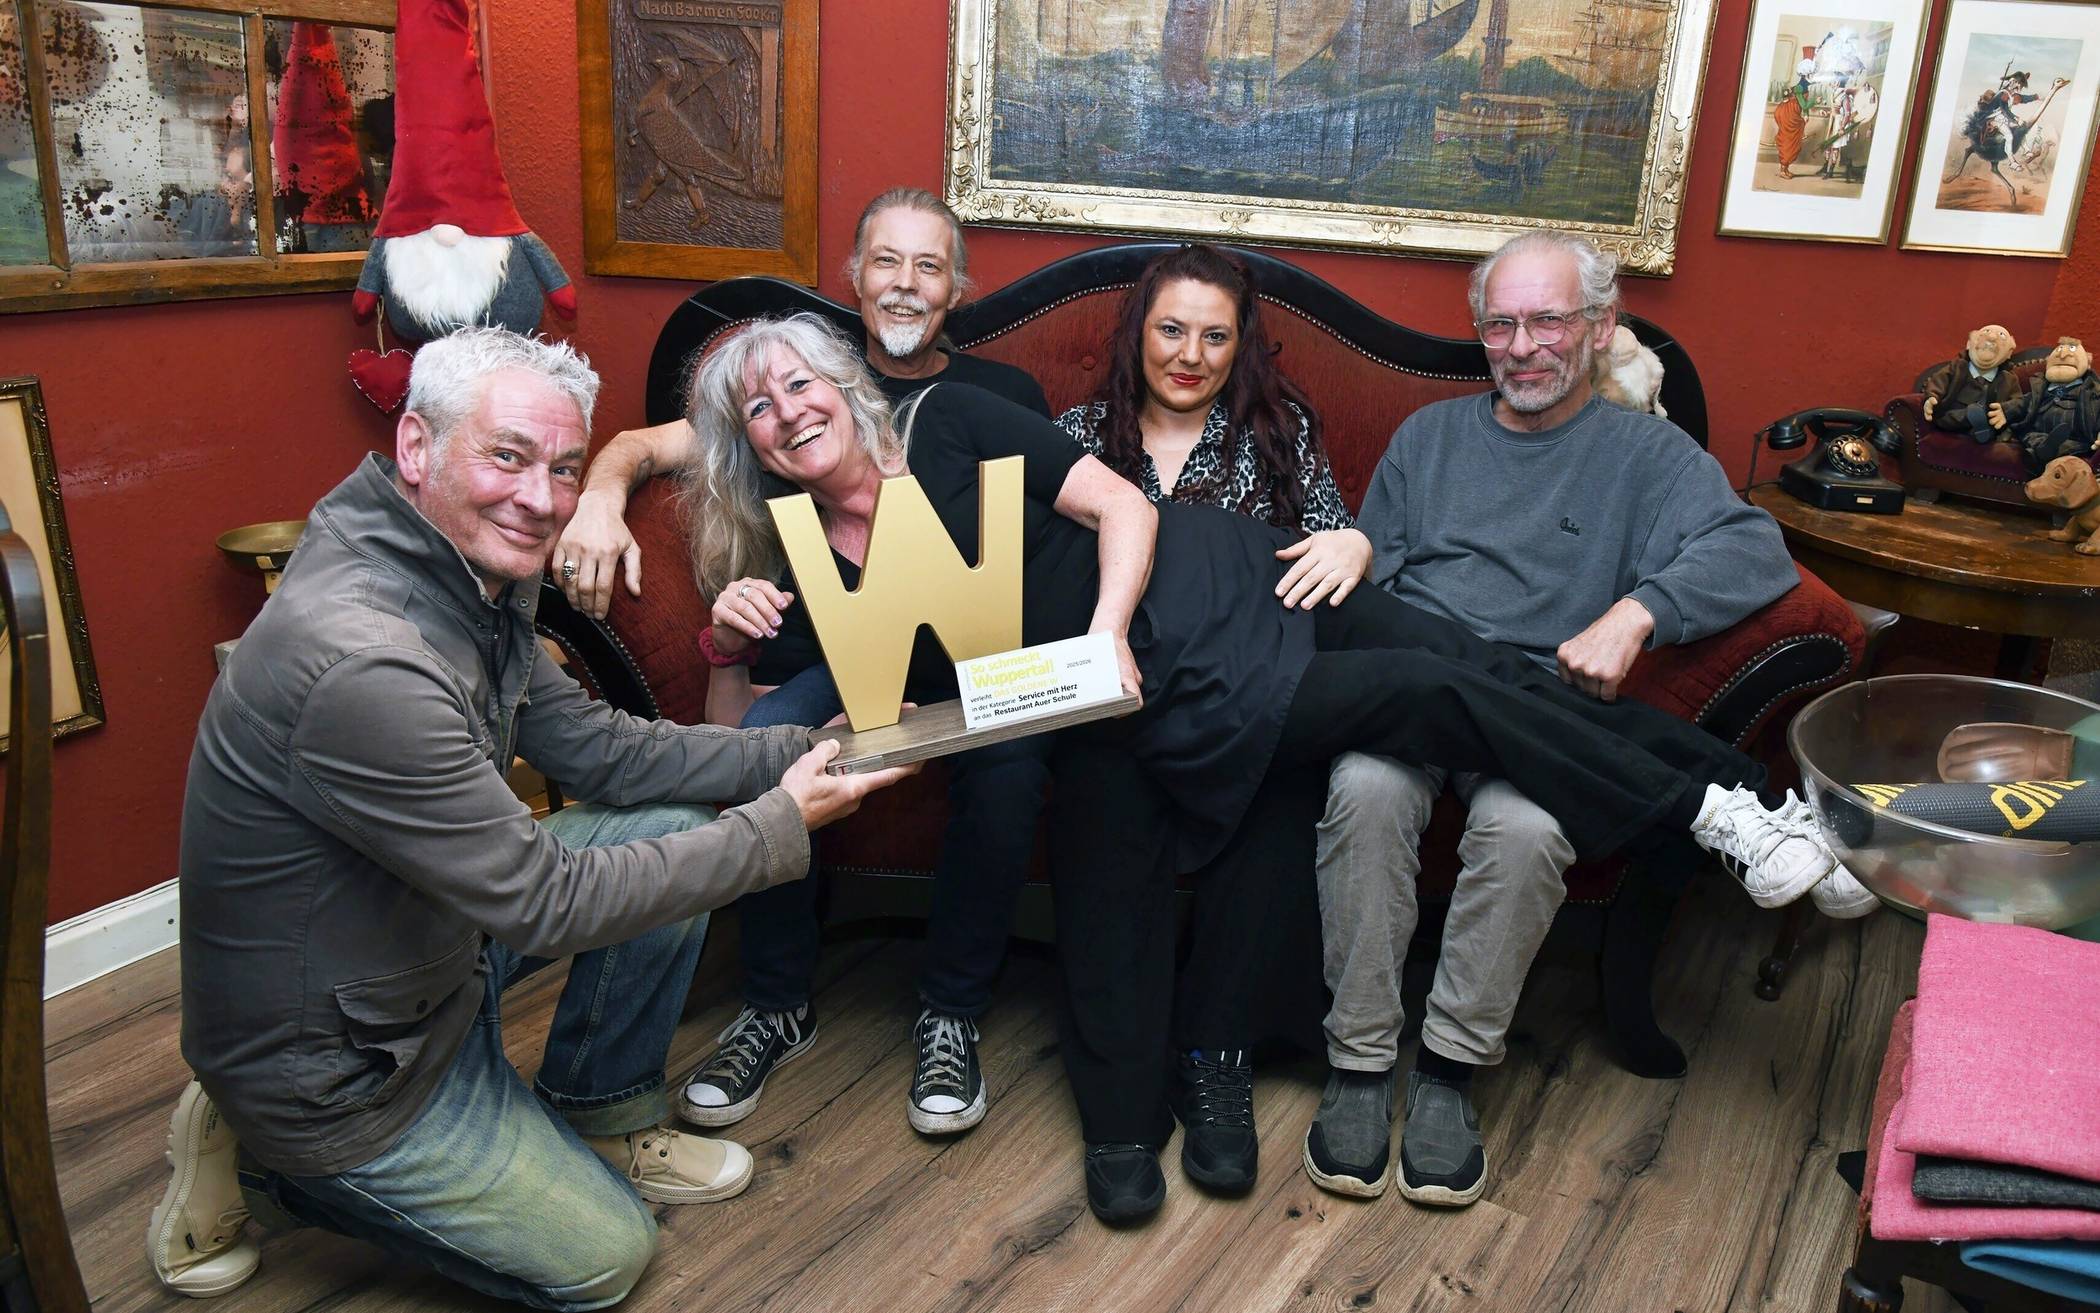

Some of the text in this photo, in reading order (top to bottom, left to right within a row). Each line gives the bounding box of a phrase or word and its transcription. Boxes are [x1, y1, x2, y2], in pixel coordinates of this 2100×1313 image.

[675, 2, 735, 18] Barmen
[765, 454, 1025, 733] W
[970, 652, 1040, 674] So schmeckt
[970, 693, 993, 703] verleiht
[978, 704, 988, 712] der
[989, 698, 1016, 709] Kategorie
[1018, 690, 1045, 702] Service
[1046, 686, 1060, 696] mit
[1060, 683, 1078, 693] Herz
[994, 702, 1033, 716] Restaurant
[1034, 698, 1051, 707] Auer
[1052, 692, 1077, 703] Schule
